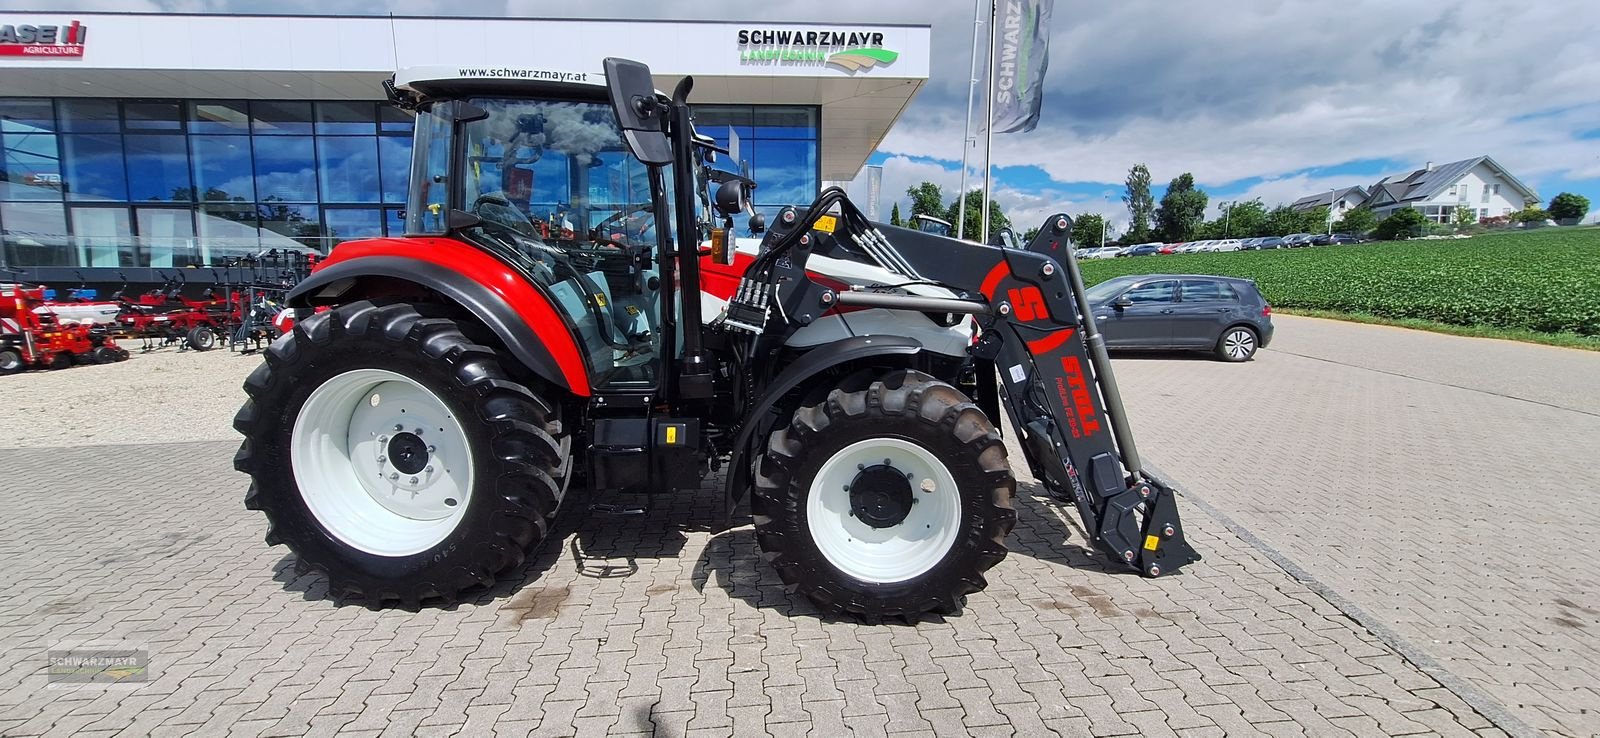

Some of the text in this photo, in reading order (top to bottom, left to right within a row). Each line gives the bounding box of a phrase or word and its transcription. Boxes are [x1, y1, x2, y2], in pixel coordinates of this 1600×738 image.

[0, 24, 58, 44] ASE
[738, 29, 884, 46] SCHWARZMAYR
[23, 46, 80, 54] AGRICULTURE
[740, 49, 826, 62] LANDTECHNIK
[997, 0, 1021, 104] SCHWARZ
[459, 67, 587, 82] www.schwarzmayr.at
[1061, 355, 1101, 437] STOLL
